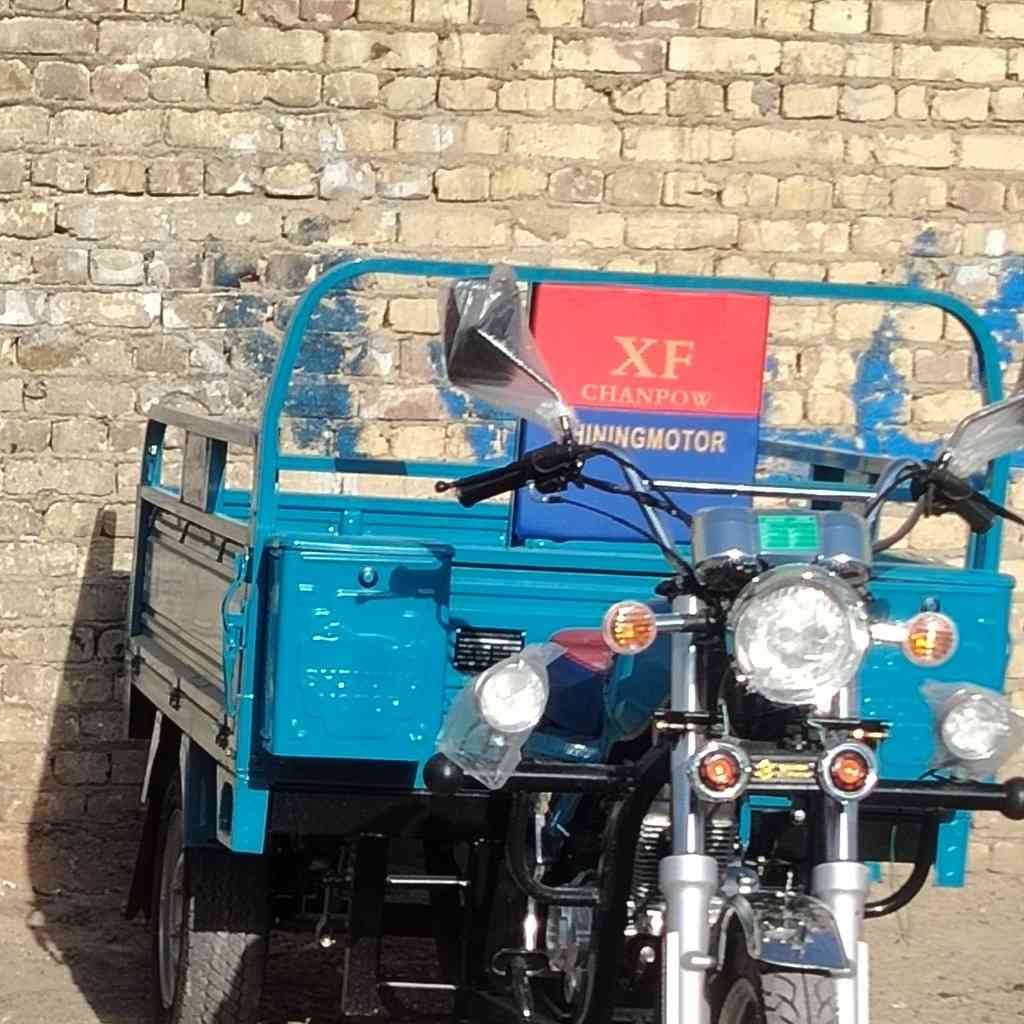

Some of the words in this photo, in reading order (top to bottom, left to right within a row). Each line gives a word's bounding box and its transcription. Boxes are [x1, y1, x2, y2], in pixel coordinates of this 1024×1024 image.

[610, 335, 696, 380] XF
[581, 383, 713, 407] CHANPOW
[572, 422, 726, 453] HININGMOTOR
